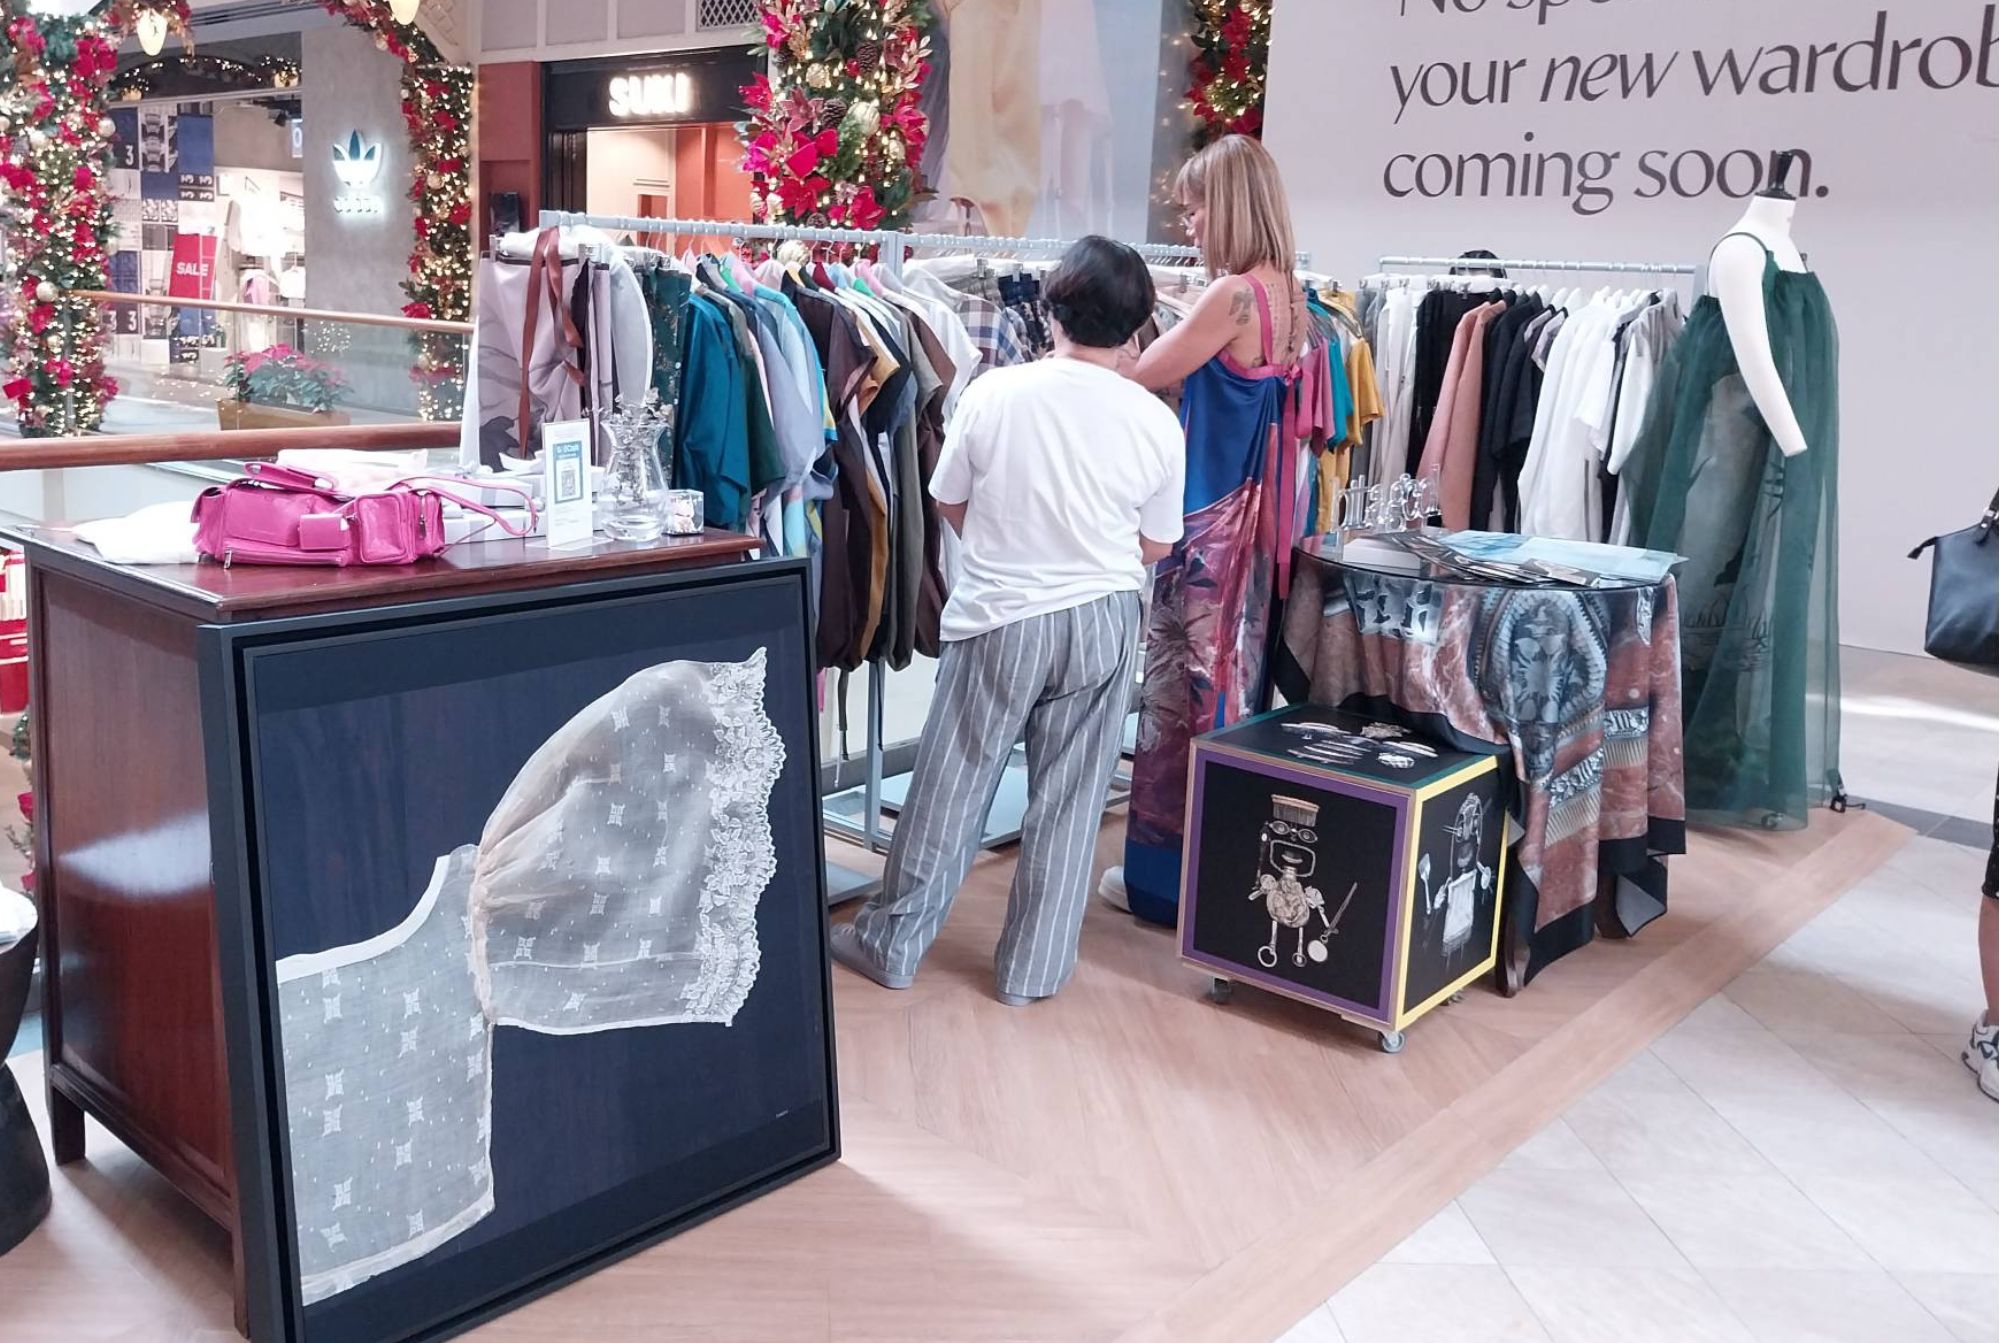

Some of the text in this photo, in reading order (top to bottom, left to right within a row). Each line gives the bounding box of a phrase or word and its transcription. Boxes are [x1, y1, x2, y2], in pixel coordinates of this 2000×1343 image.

[1390, 58, 1527, 125] your
[1540, 50, 1679, 102] new
[125, 144, 135, 166] 3
[1383, 131, 1830, 216] coming soon.
[176, 261, 209, 277] SALE
[128, 310, 137, 331] 3
